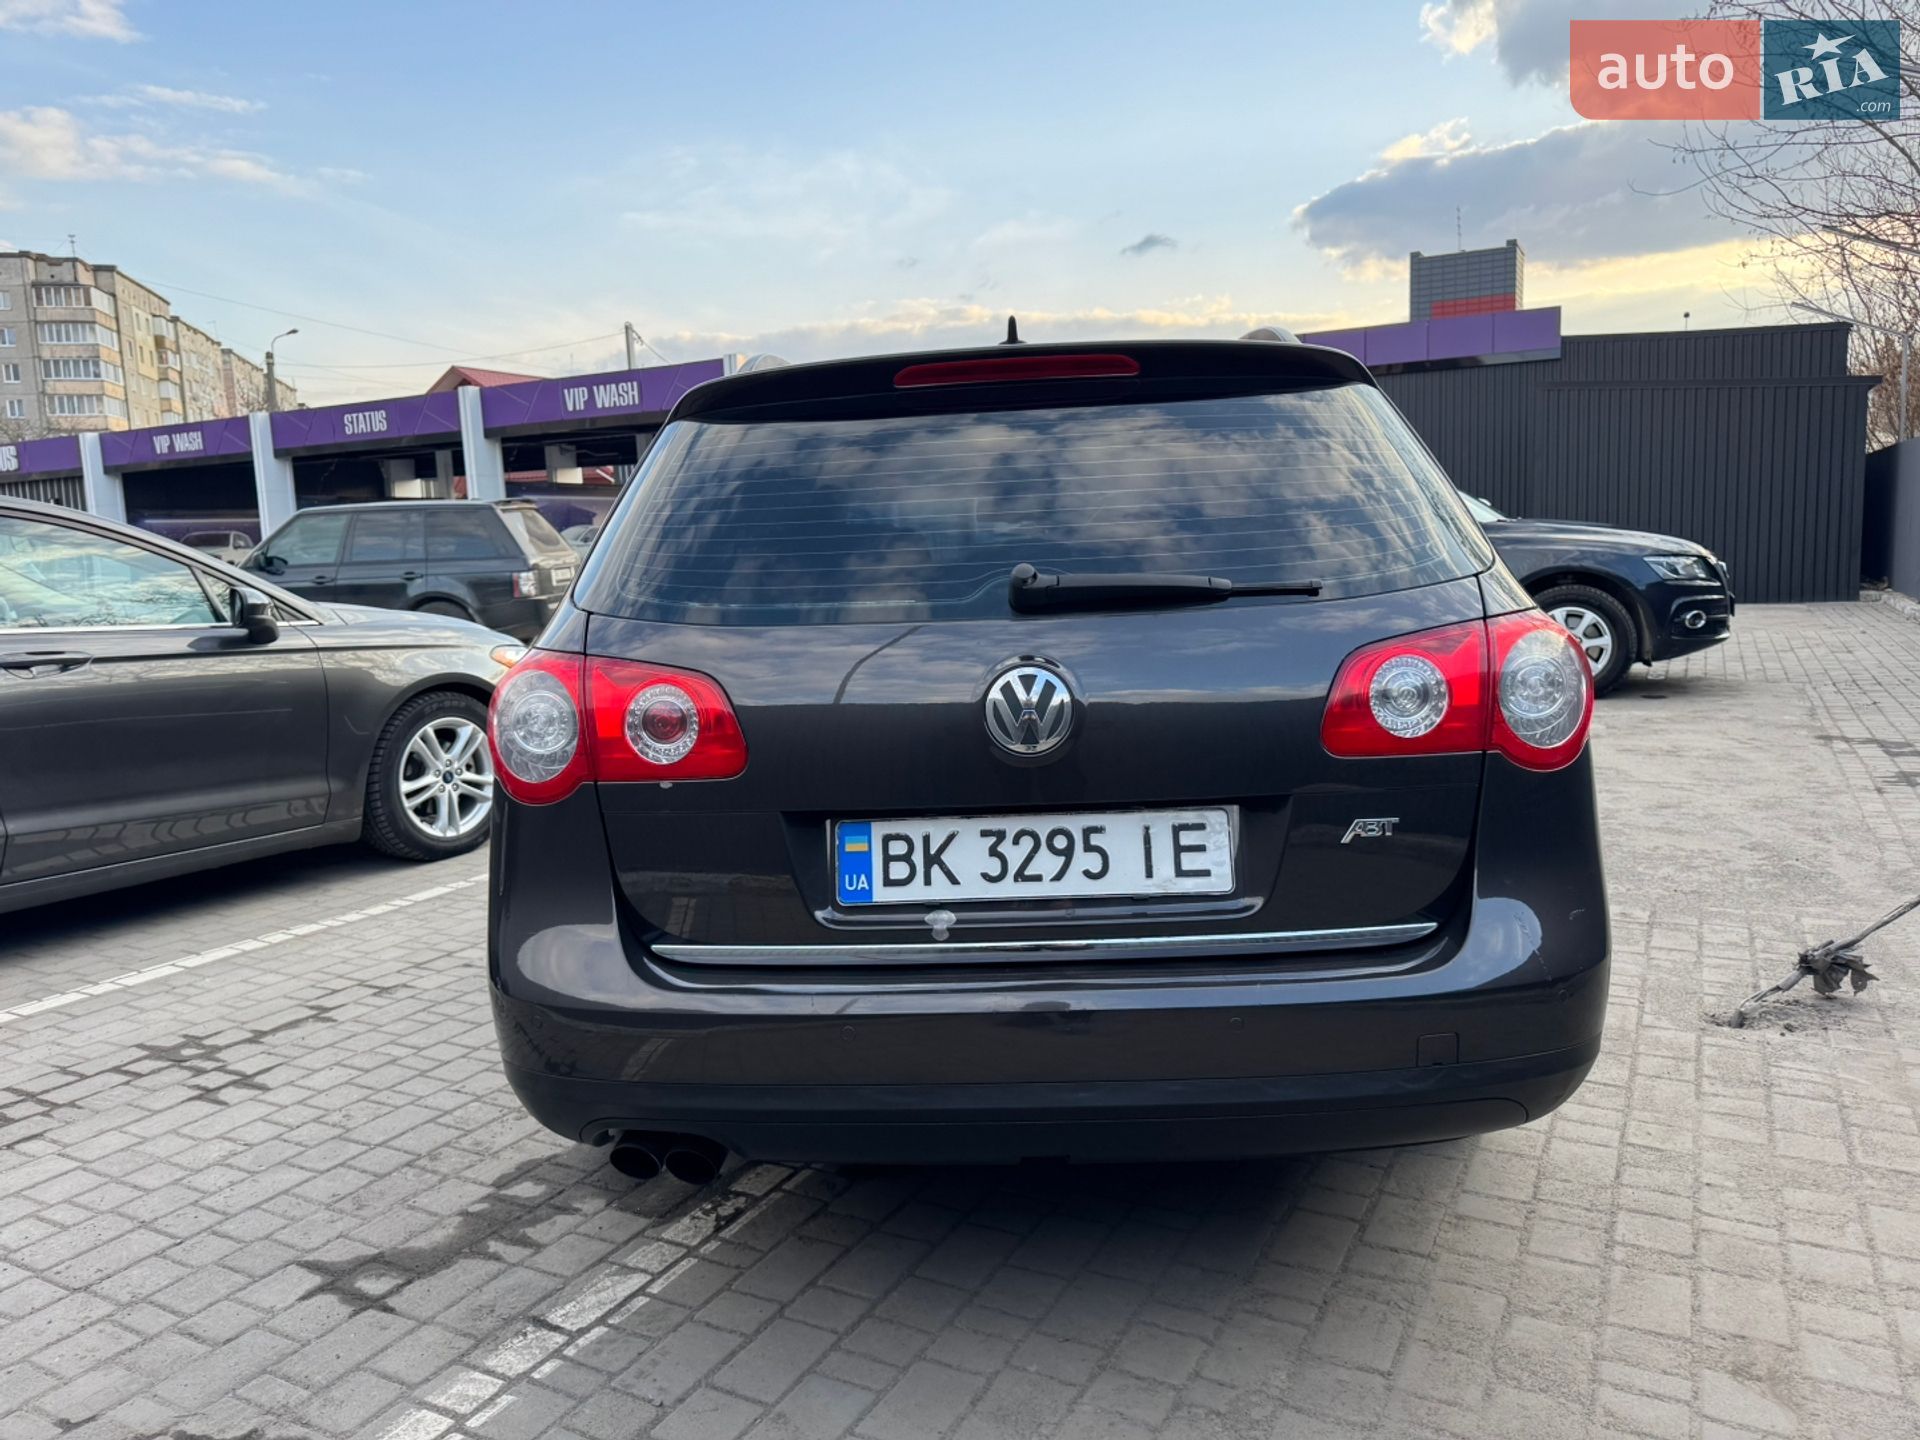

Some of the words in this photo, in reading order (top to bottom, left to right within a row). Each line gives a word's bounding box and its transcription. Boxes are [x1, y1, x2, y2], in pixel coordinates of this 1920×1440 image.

[563, 387, 589, 412] VIP
[593, 381, 639, 409] WASH
[343, 410, 388, 435] STATUS
[152, 434, 171, 454] VIP
[172, 431, 204, 452] WASH
[1340, 817, 1400, 844] ABT
[881, 829, 961, 888] BK
[979, 826, 1110, 884] 3295
[1142, 822, 1212, 879] IE
[845, 874, 869, 891] UA
